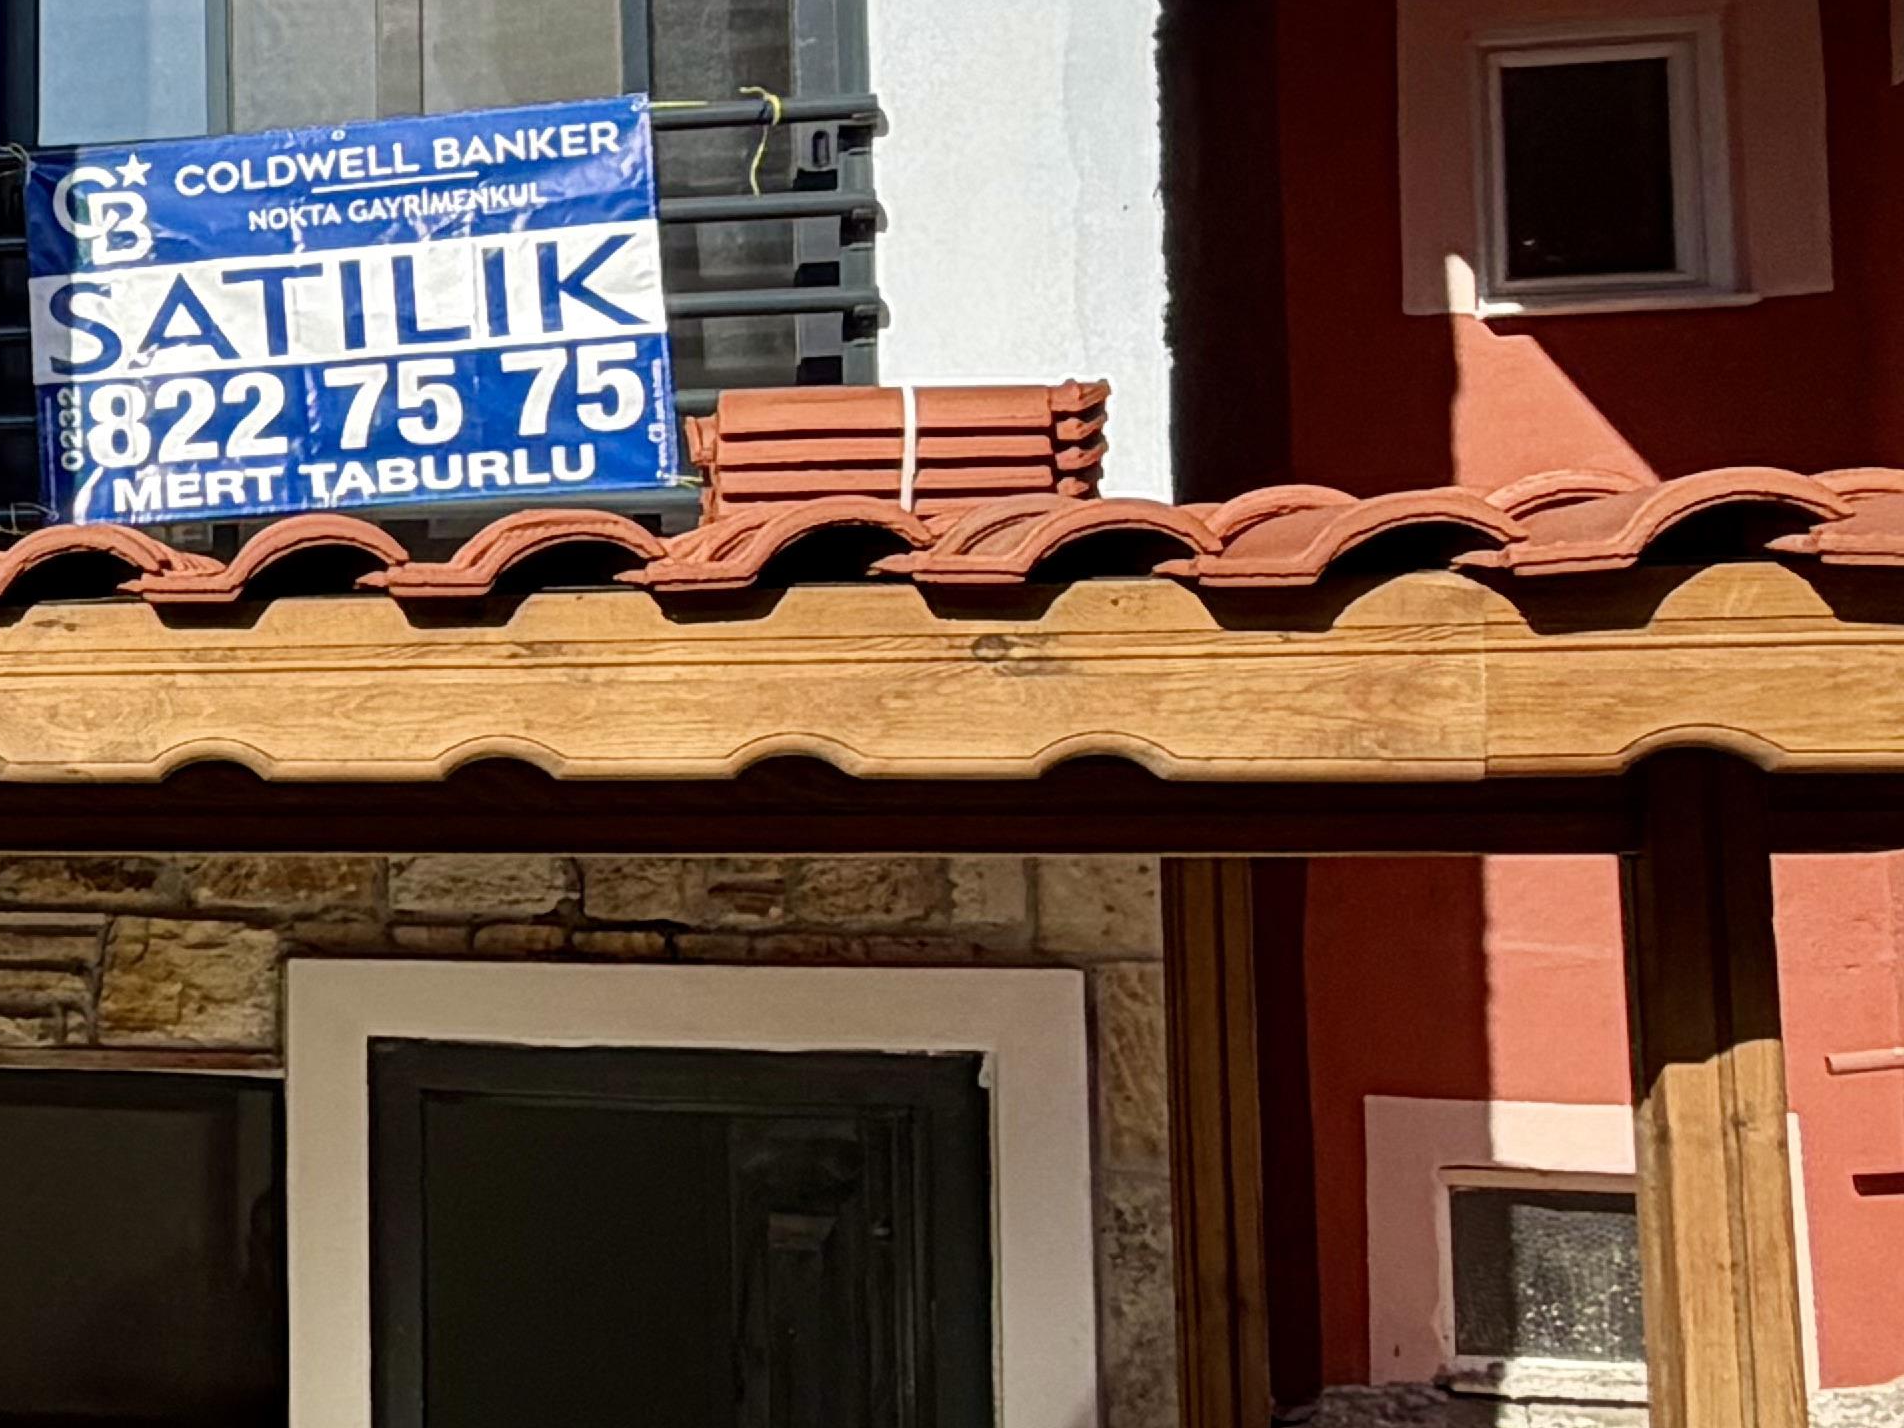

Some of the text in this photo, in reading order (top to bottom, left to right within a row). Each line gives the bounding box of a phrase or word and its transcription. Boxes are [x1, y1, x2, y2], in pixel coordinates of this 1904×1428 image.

[175, 120, 621, 197] COLDWELL BANKER
[248, 180, 548, 232] NOKTA GAYRİMENKUL
[49, 232, 648, 375] SATILIK
[58, 386, 85, 472] 0232
[86, 371, 289, 468] 822
[323, 357, 464, 450] 75
[500, 341, 645, 432] 75
[112, 442, 597, 513] MERT TABURLU
